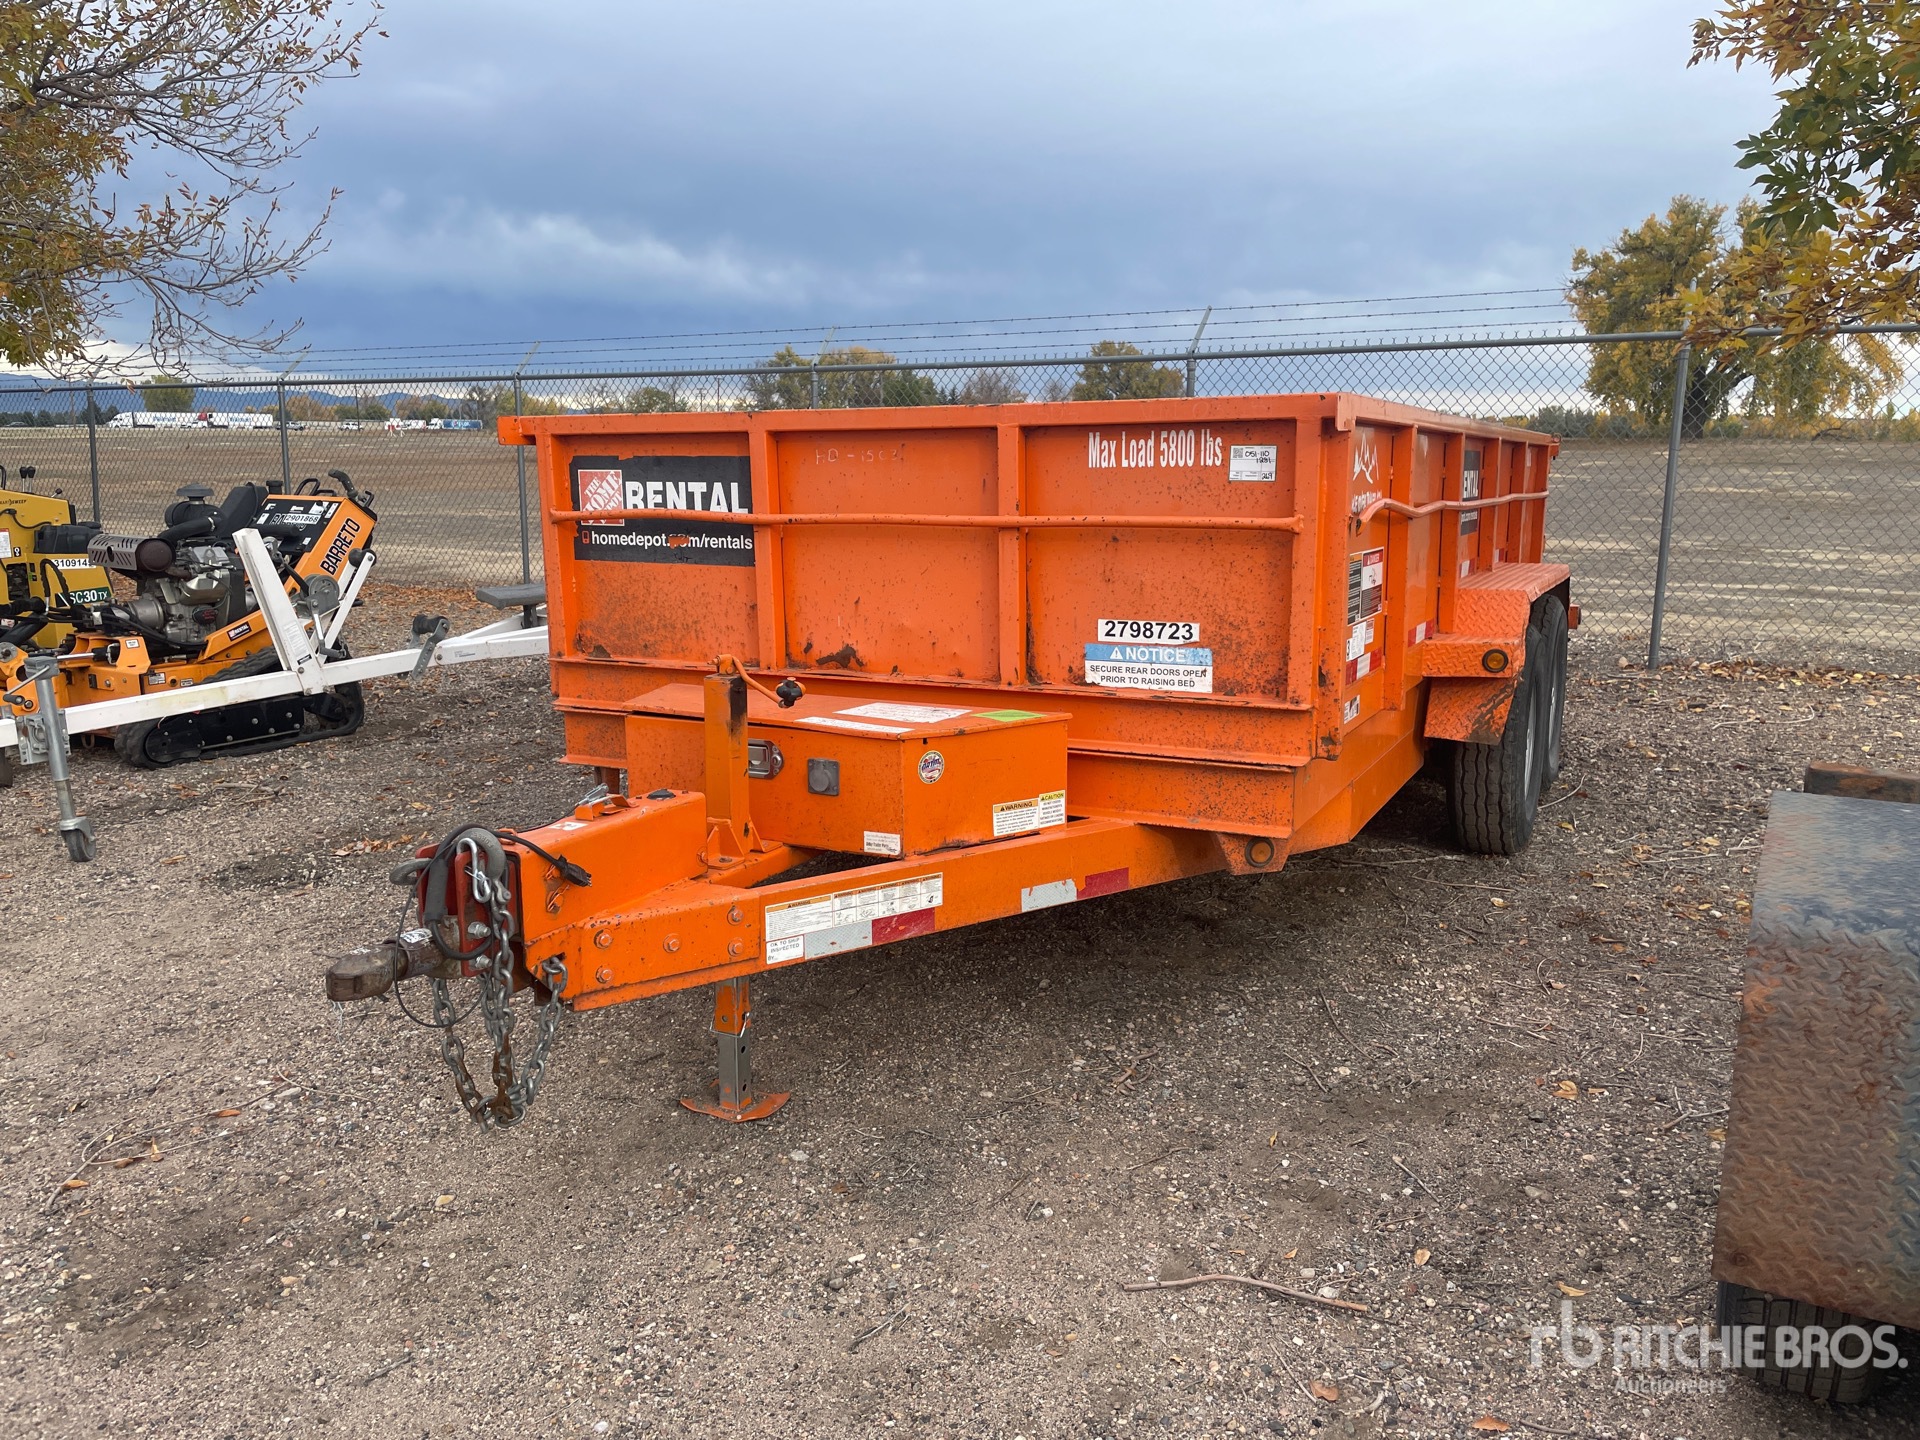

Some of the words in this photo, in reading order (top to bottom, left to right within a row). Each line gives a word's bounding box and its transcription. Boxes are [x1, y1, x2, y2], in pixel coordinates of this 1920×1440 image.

[1088, 431, 1117, 469] Max
[1121, 430, 1155, 468] Load
[1159, 429, 1195, 468] 5800
[1200, 428, 1223, 467] lbs
[583, 476, 601, 498] THE
[625, 481, 749, 514] RENTAL
[320, 518, 361, 576] BARRETO
[1104, 620, 1194, 641] 2798723
[1125, 647, 1187, 663] NOTICE
[1089, 664, 1123, 674] SECURE
[1125, 666, 1148, 675] REAR
[1150, 667, 1181, 677] DOORS
[1182, 669, 1207, 678] OPEN
[1100, 675, 1123, 684] PRIOR
[1127, 676, 1140, 684] TO
[1141, 677, 1176, 686] RAISING
[1177, 679, 1196, 688] BED
[1005, 801, 1033, 811] WARNING
